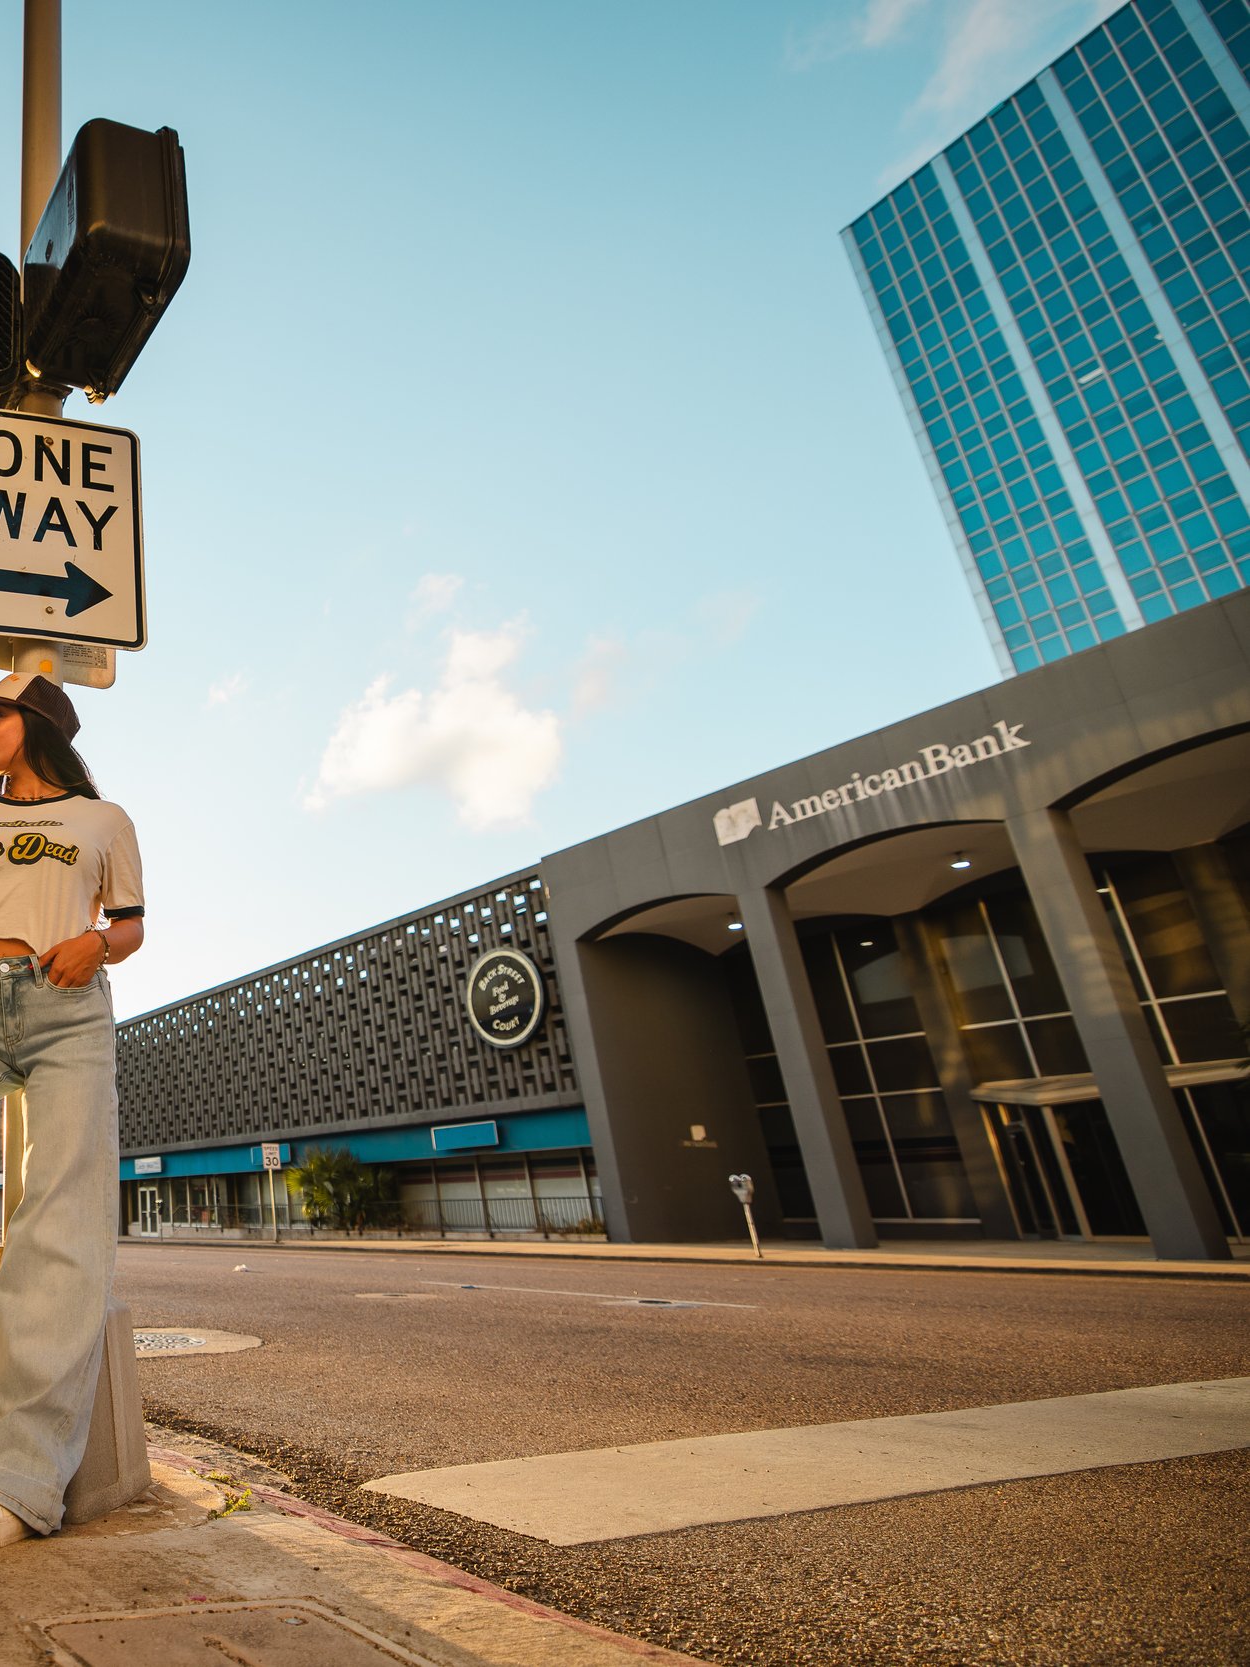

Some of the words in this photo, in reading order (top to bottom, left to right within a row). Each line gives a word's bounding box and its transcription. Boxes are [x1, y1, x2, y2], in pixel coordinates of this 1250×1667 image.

[768, 719, 1031, 830] AmericanBank
[8, 833, 80, 866] Dead
[492, 980, 509, 997] Food
[498, 993, 507, 1003] &
[492, 1016, 520, 1031] COURT
[265, 1156, 279, 1166] 30
